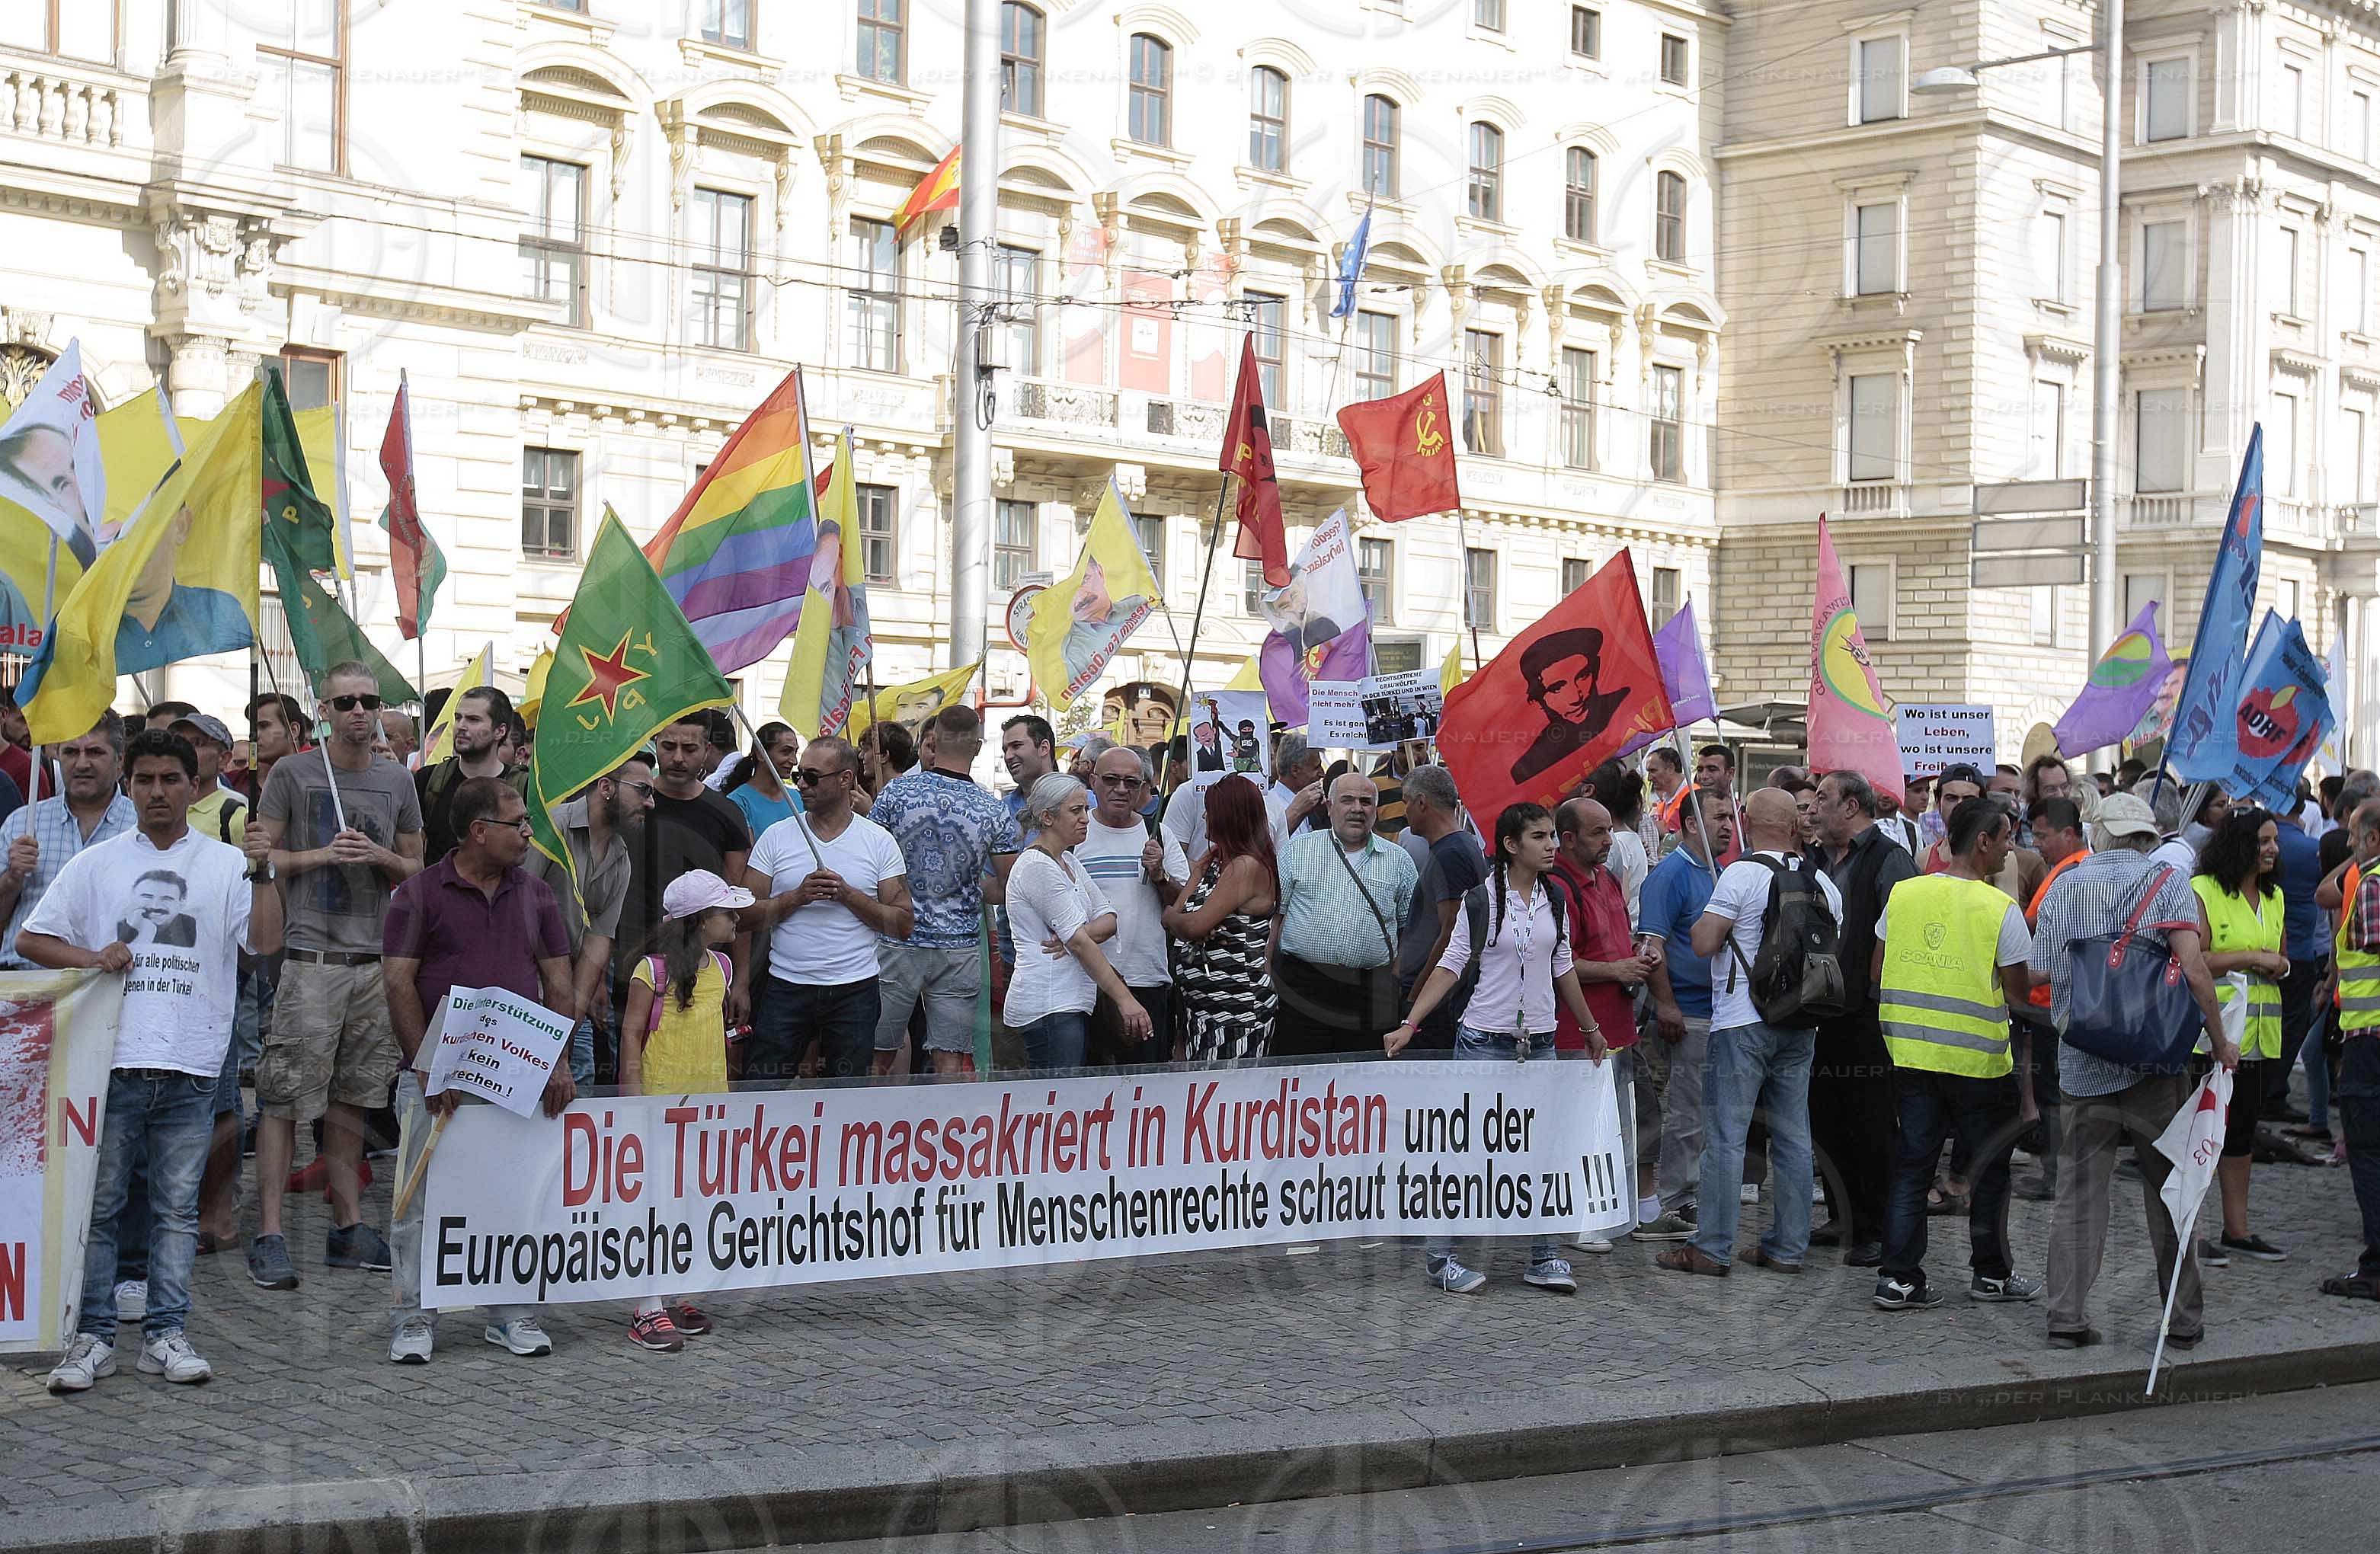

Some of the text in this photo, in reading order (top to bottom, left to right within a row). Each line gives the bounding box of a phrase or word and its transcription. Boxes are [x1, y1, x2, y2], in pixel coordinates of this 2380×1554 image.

[1422, 683, 1438, 692] WIEN
[1905, 709, 1990, 720] Wo ist unser
[1924, 727, 1969, 738] Leben,
[1924, 744, 1942, 753] ist
[1947, 746, 1992, 754] unsere
[146, 952, 160, 967] alle
[162, 954, 200, 974] politischen
[1900, 948, 1966, 972] SCANIA
[123, 980, 145, 996] genen
[147, 976, 155, 991] in
[157, 977, 171, 993] der
[453, 996, 565, 1041] Die terstützung
[480, 1014, 498, 1026] des
[467, 1048, 501, 1070] kein
[500, 1038, 550, 1070] Volkes
[563, 1076, 1536, 1207] Die Türkei massakriert in Kurdistan und der
[436, 1206, 694, 1301] Europäische
[706, 1186, 926, 1272] Gerichtshof
[935, 1185, 987, 1255] für
[996, 1168, 1269, 1249] Menschenrechte
[1279, 1161, 1387, 1226] schaut
[1396, 1158, 1533, 1220] tatenlos
[1540, 1172, 1573, 1217] zu
